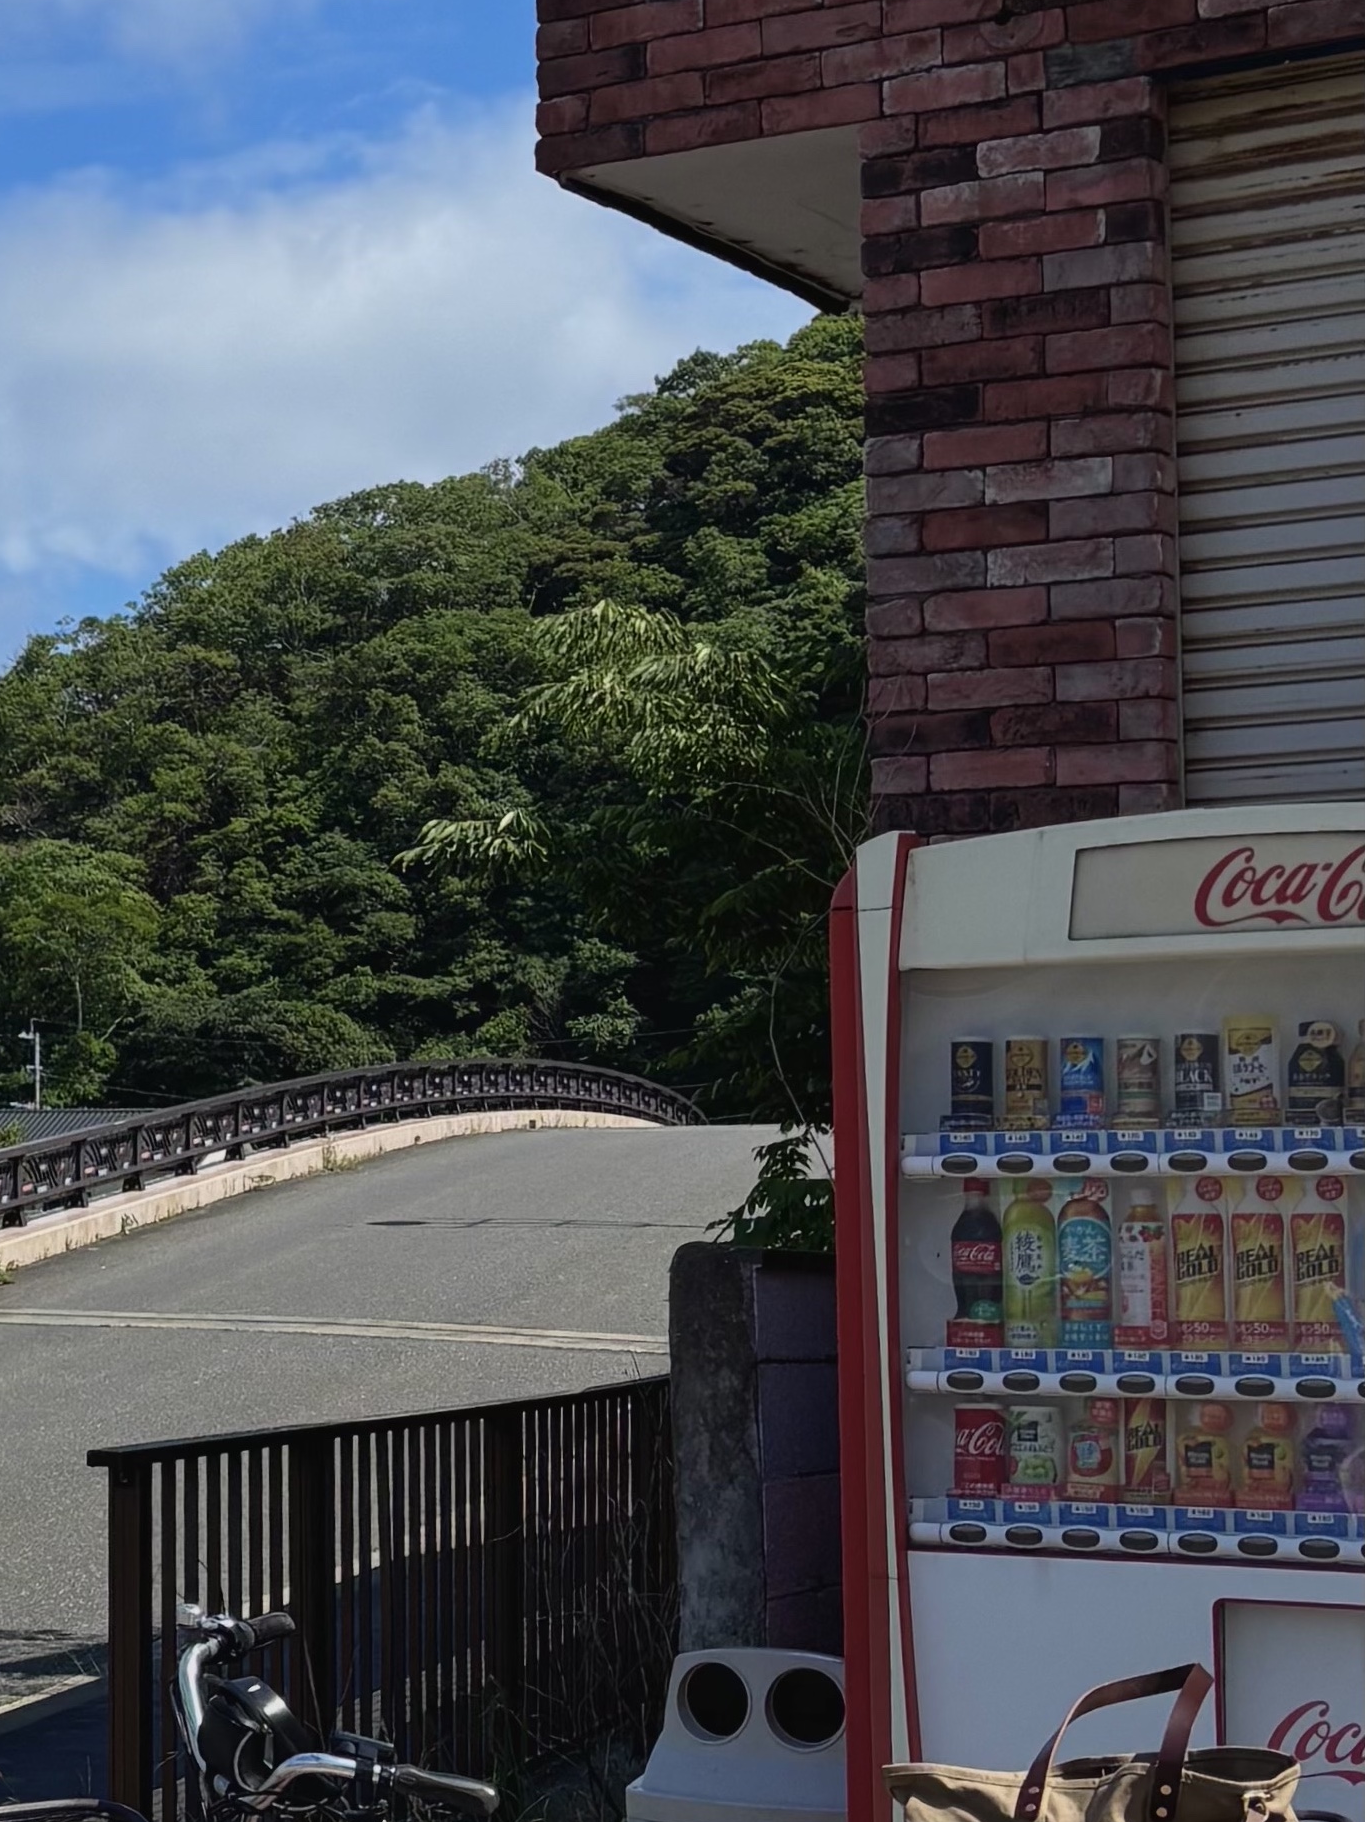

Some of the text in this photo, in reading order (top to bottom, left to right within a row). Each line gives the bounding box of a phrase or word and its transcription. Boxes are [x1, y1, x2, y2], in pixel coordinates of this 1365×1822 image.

[1177, 1258, 1218, 1281] GOLD
[1237, 1258, 1278, 1281] GOLD
[1297, 1258, 1338, 1281] GOLD
